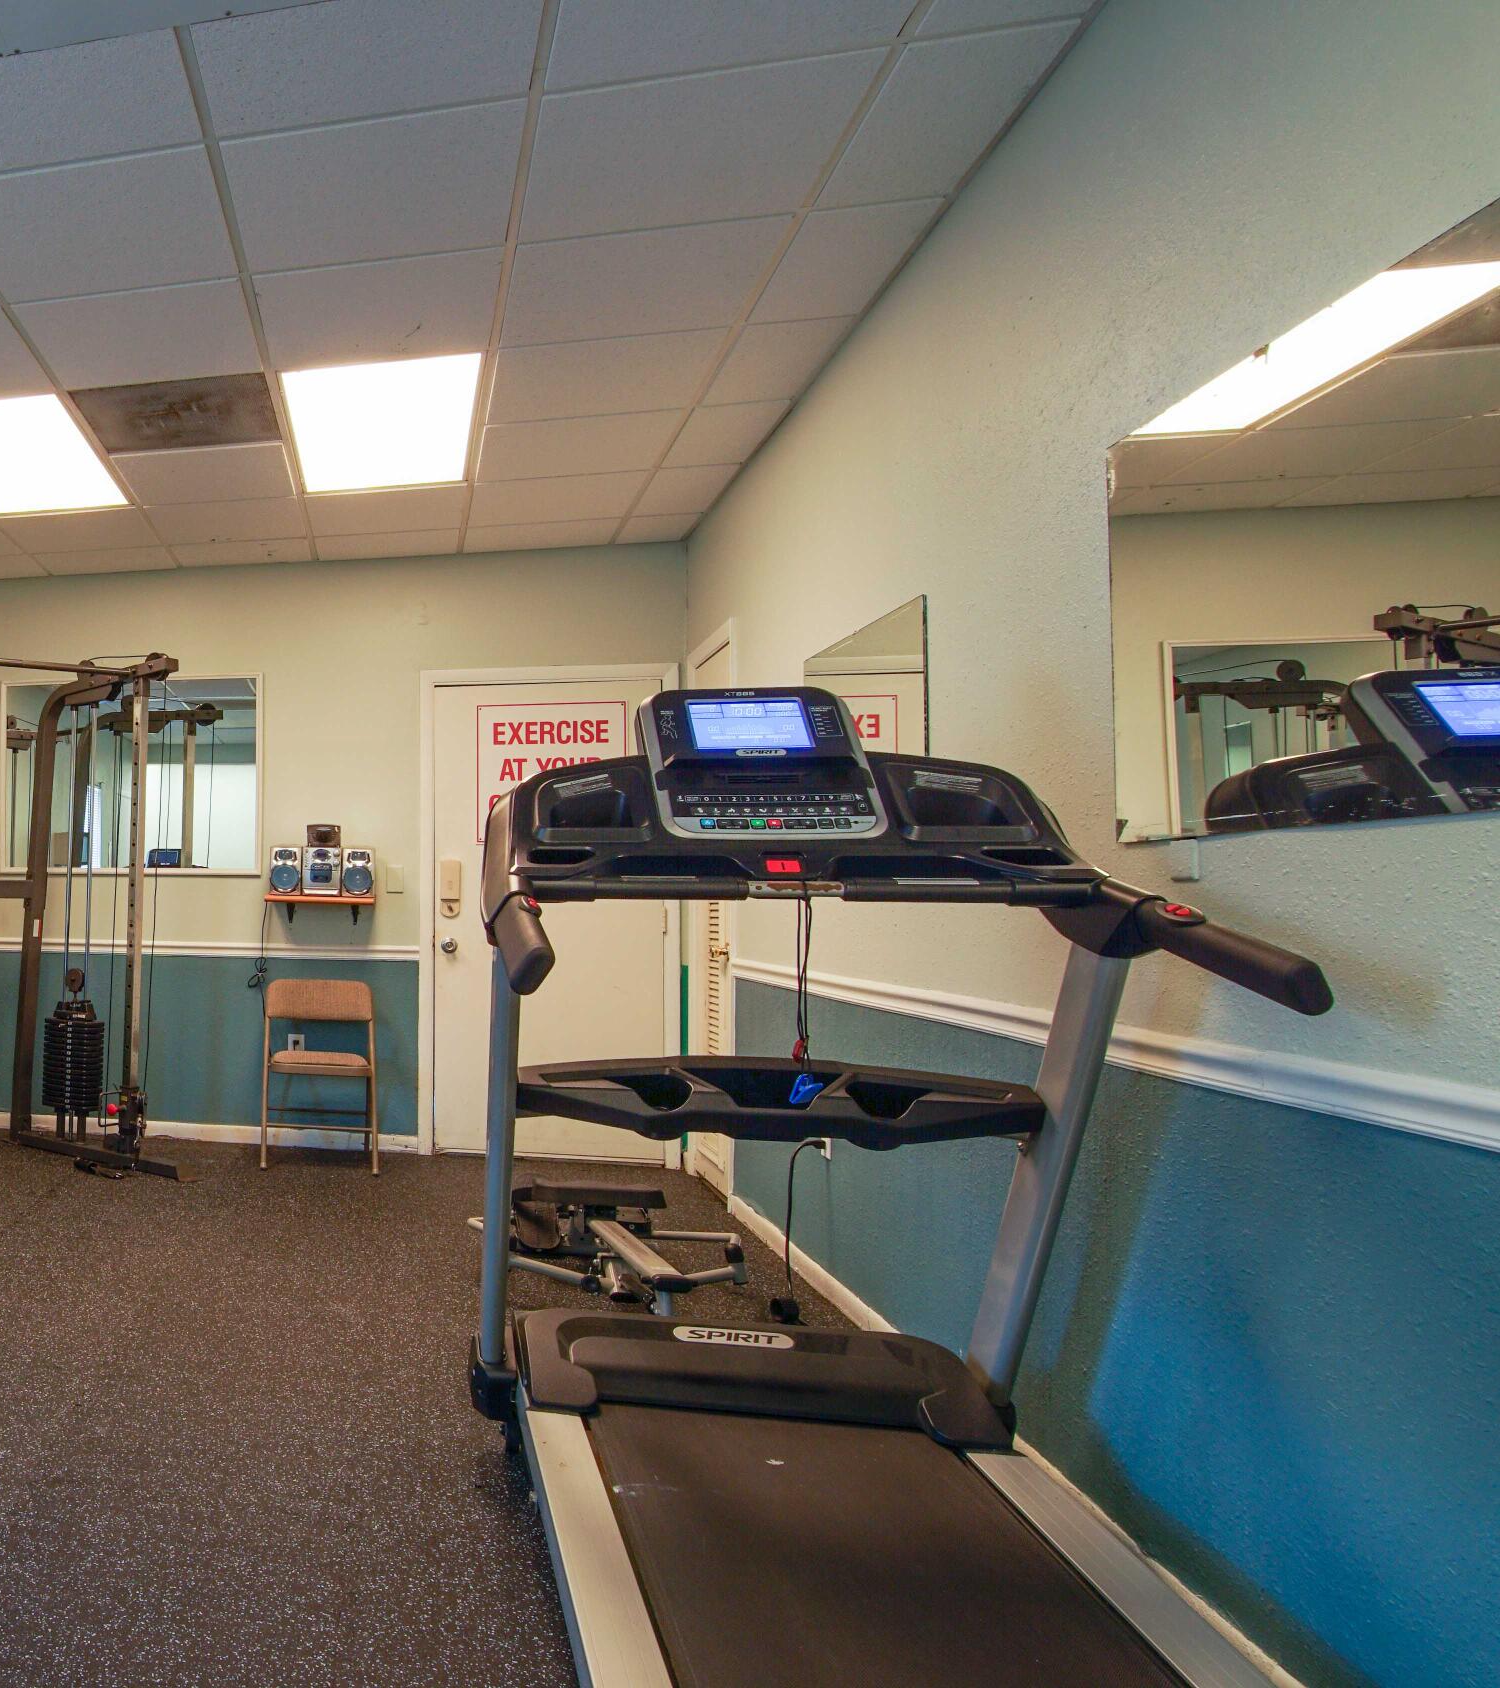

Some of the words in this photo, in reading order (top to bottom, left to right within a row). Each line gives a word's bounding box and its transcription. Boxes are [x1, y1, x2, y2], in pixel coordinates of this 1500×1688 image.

[493, 719, 609, 745] EXERCISE
[500, 758, 527, 781] AT
[687, 1329, 780, 1345] SPIRIT
